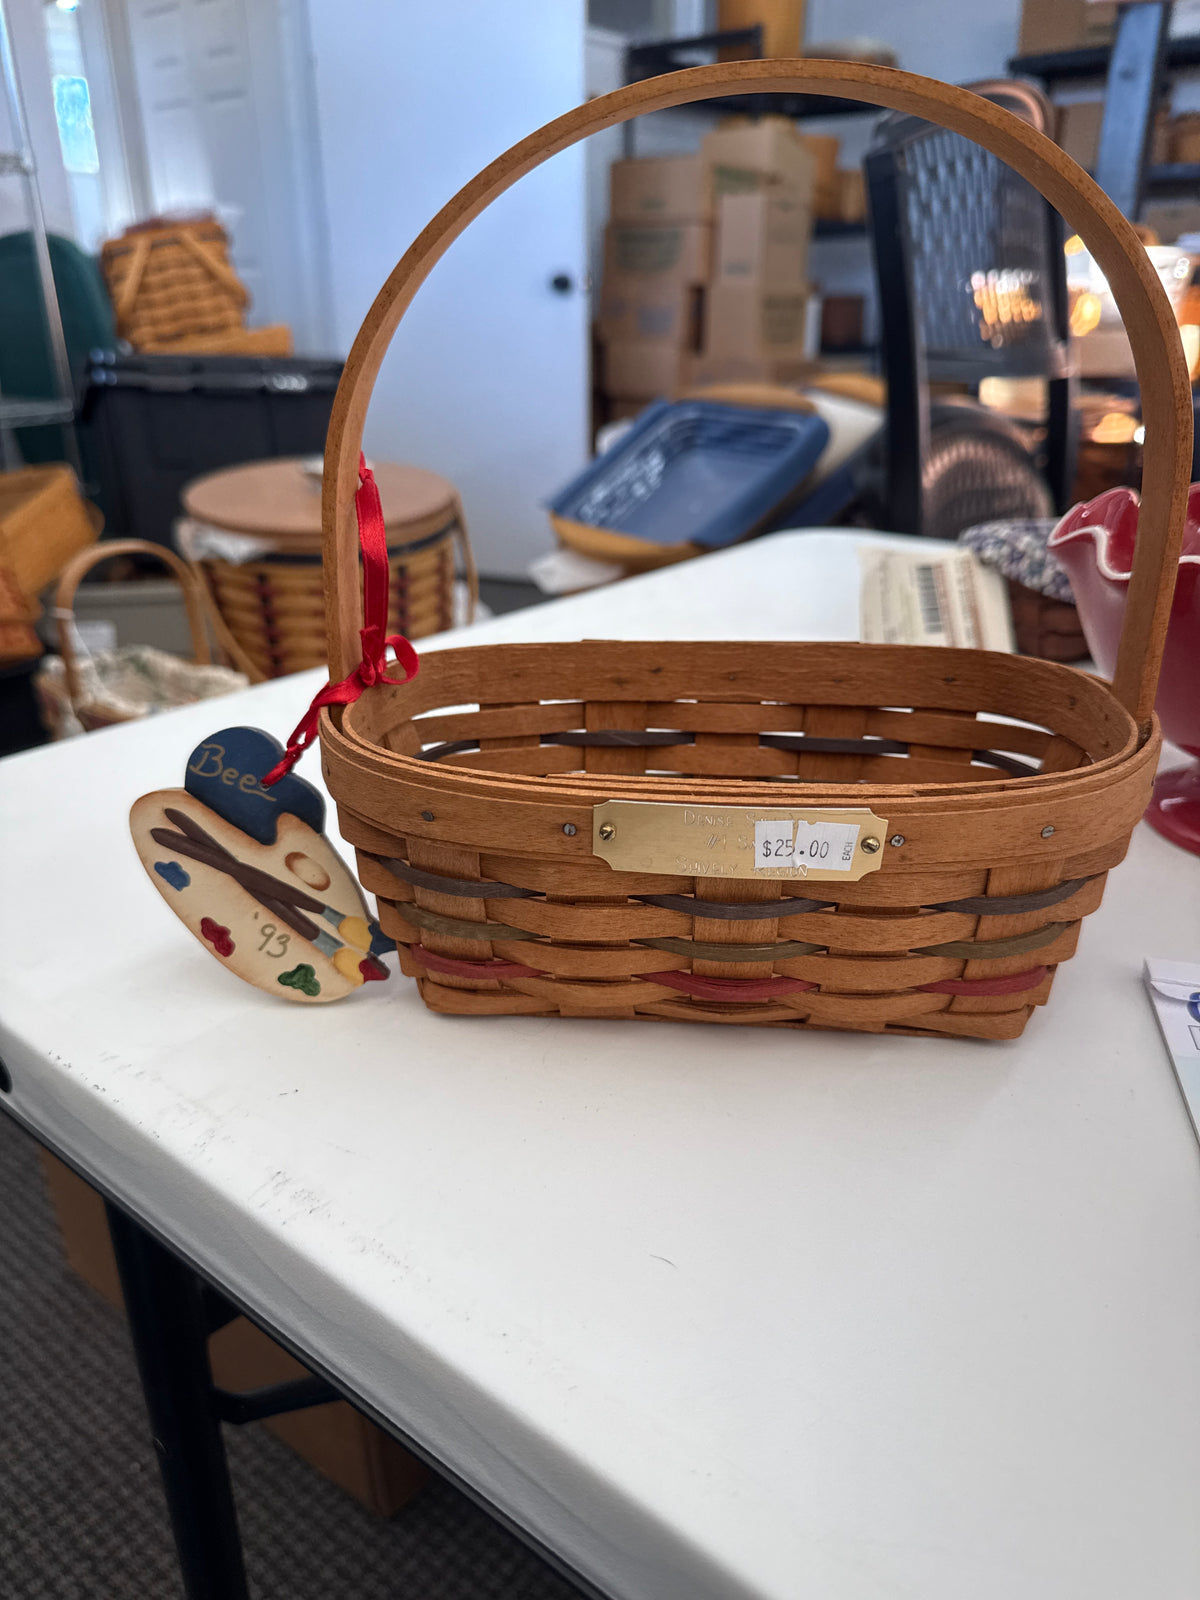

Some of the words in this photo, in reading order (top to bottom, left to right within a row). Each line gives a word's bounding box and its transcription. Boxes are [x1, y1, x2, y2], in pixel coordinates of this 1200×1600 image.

[684, 809, 733, 827] DENISE
[762, 838, 830, 859] $25.00
[842, 841, 853, 861] EACH
[675, 856, 738, 874] SHIVELY
[254, 911, 291, 958] '93
